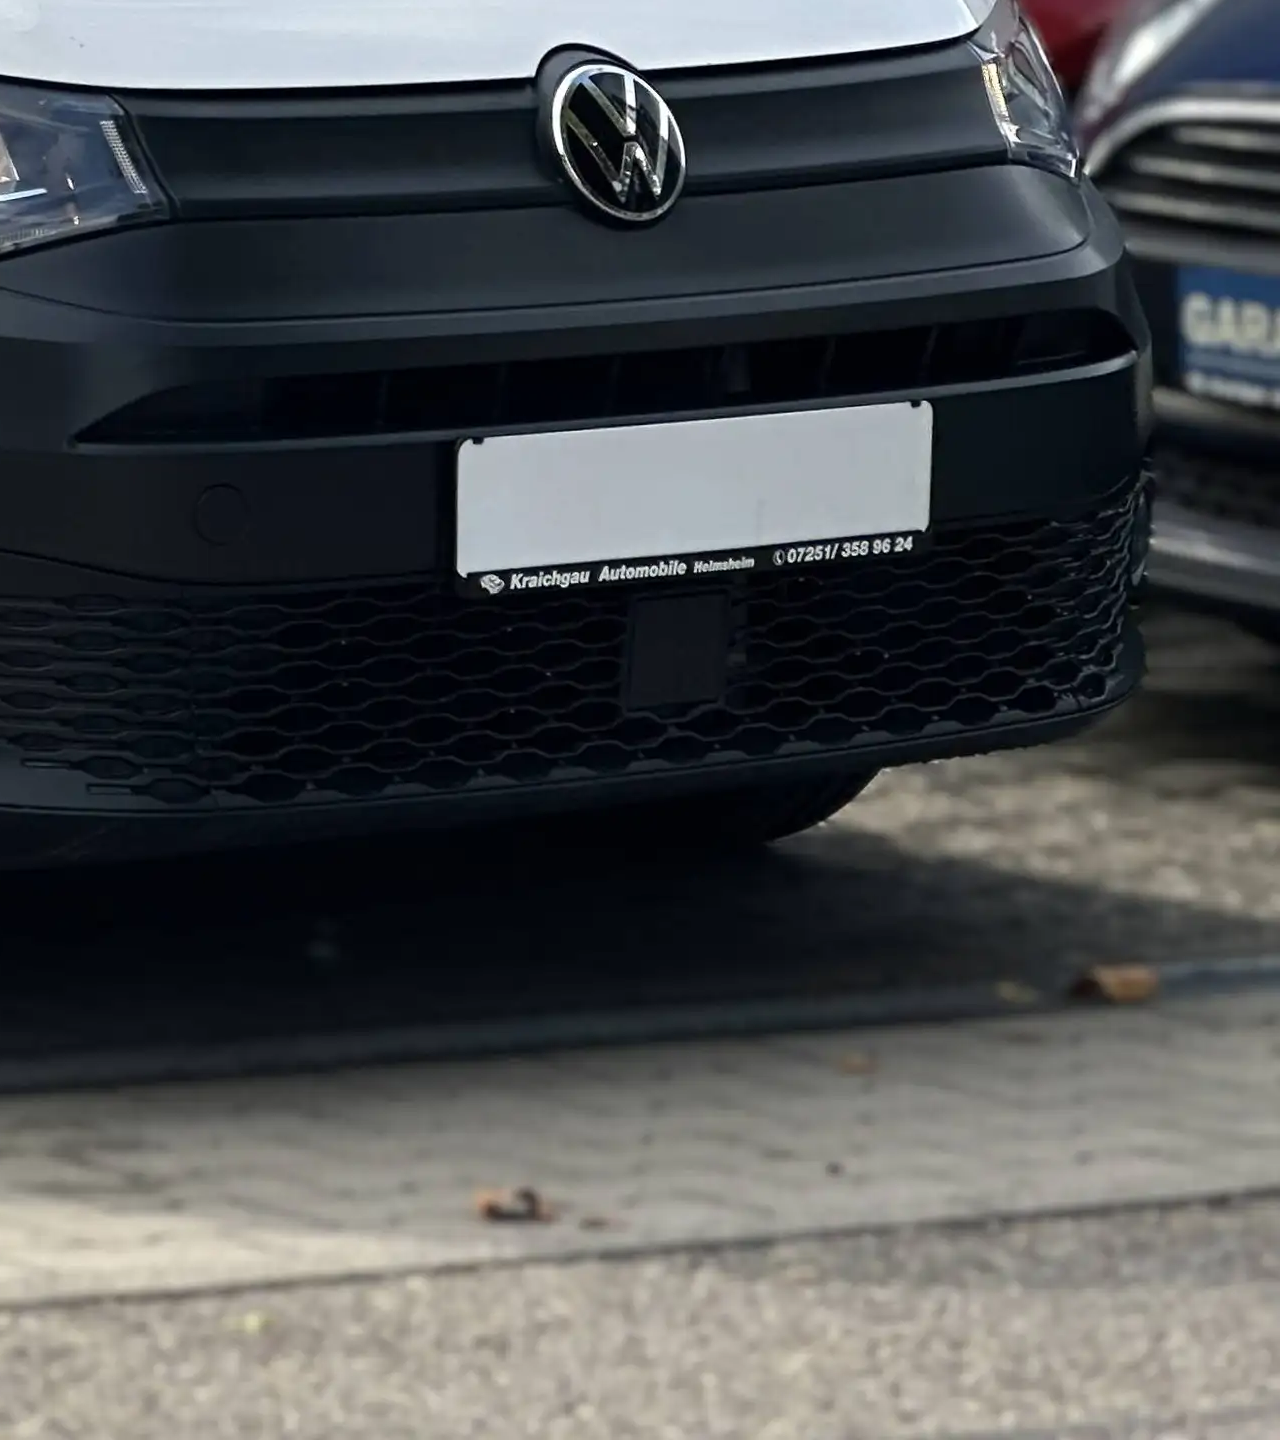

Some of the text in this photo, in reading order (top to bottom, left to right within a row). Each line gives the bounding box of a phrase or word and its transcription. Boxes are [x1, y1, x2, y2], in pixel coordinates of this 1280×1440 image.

[509, 535, 914, 590] Kraichgau Automobile Helmsheim 07251/ 358 96 24
